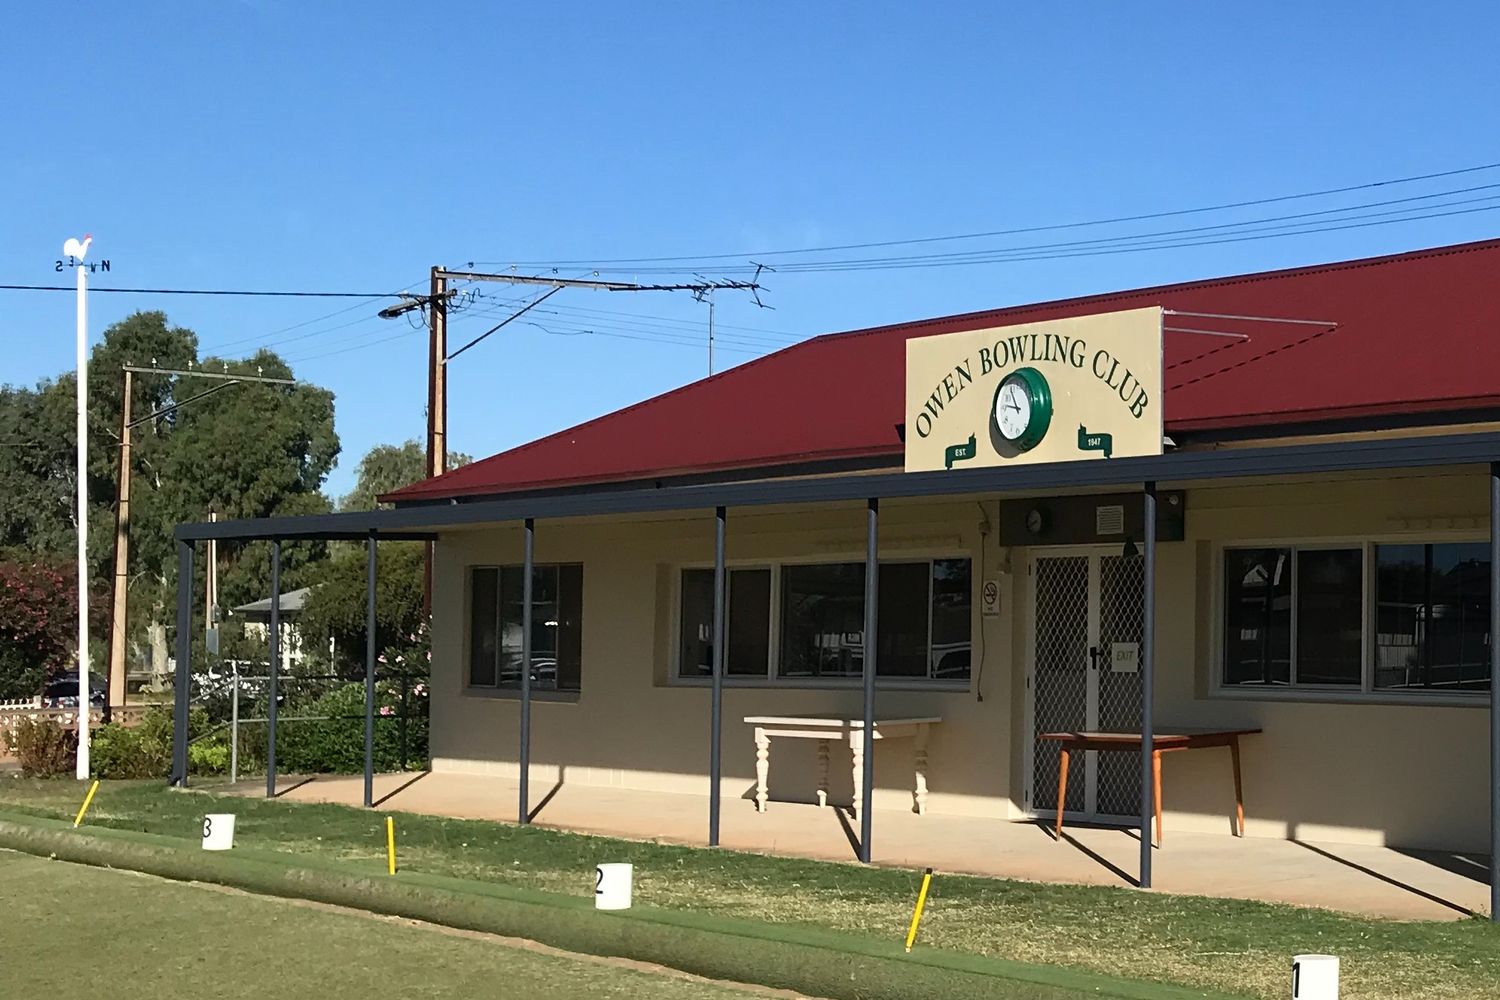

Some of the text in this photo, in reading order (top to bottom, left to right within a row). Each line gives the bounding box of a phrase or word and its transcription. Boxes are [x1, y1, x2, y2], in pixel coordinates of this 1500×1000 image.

[915, 357, 973, 438] OWEN
[979, 333, 1087, 376] BOWLING
[1092, 349, 1149, 420] CLUB
[1292, 962, 1300, 998] 1
